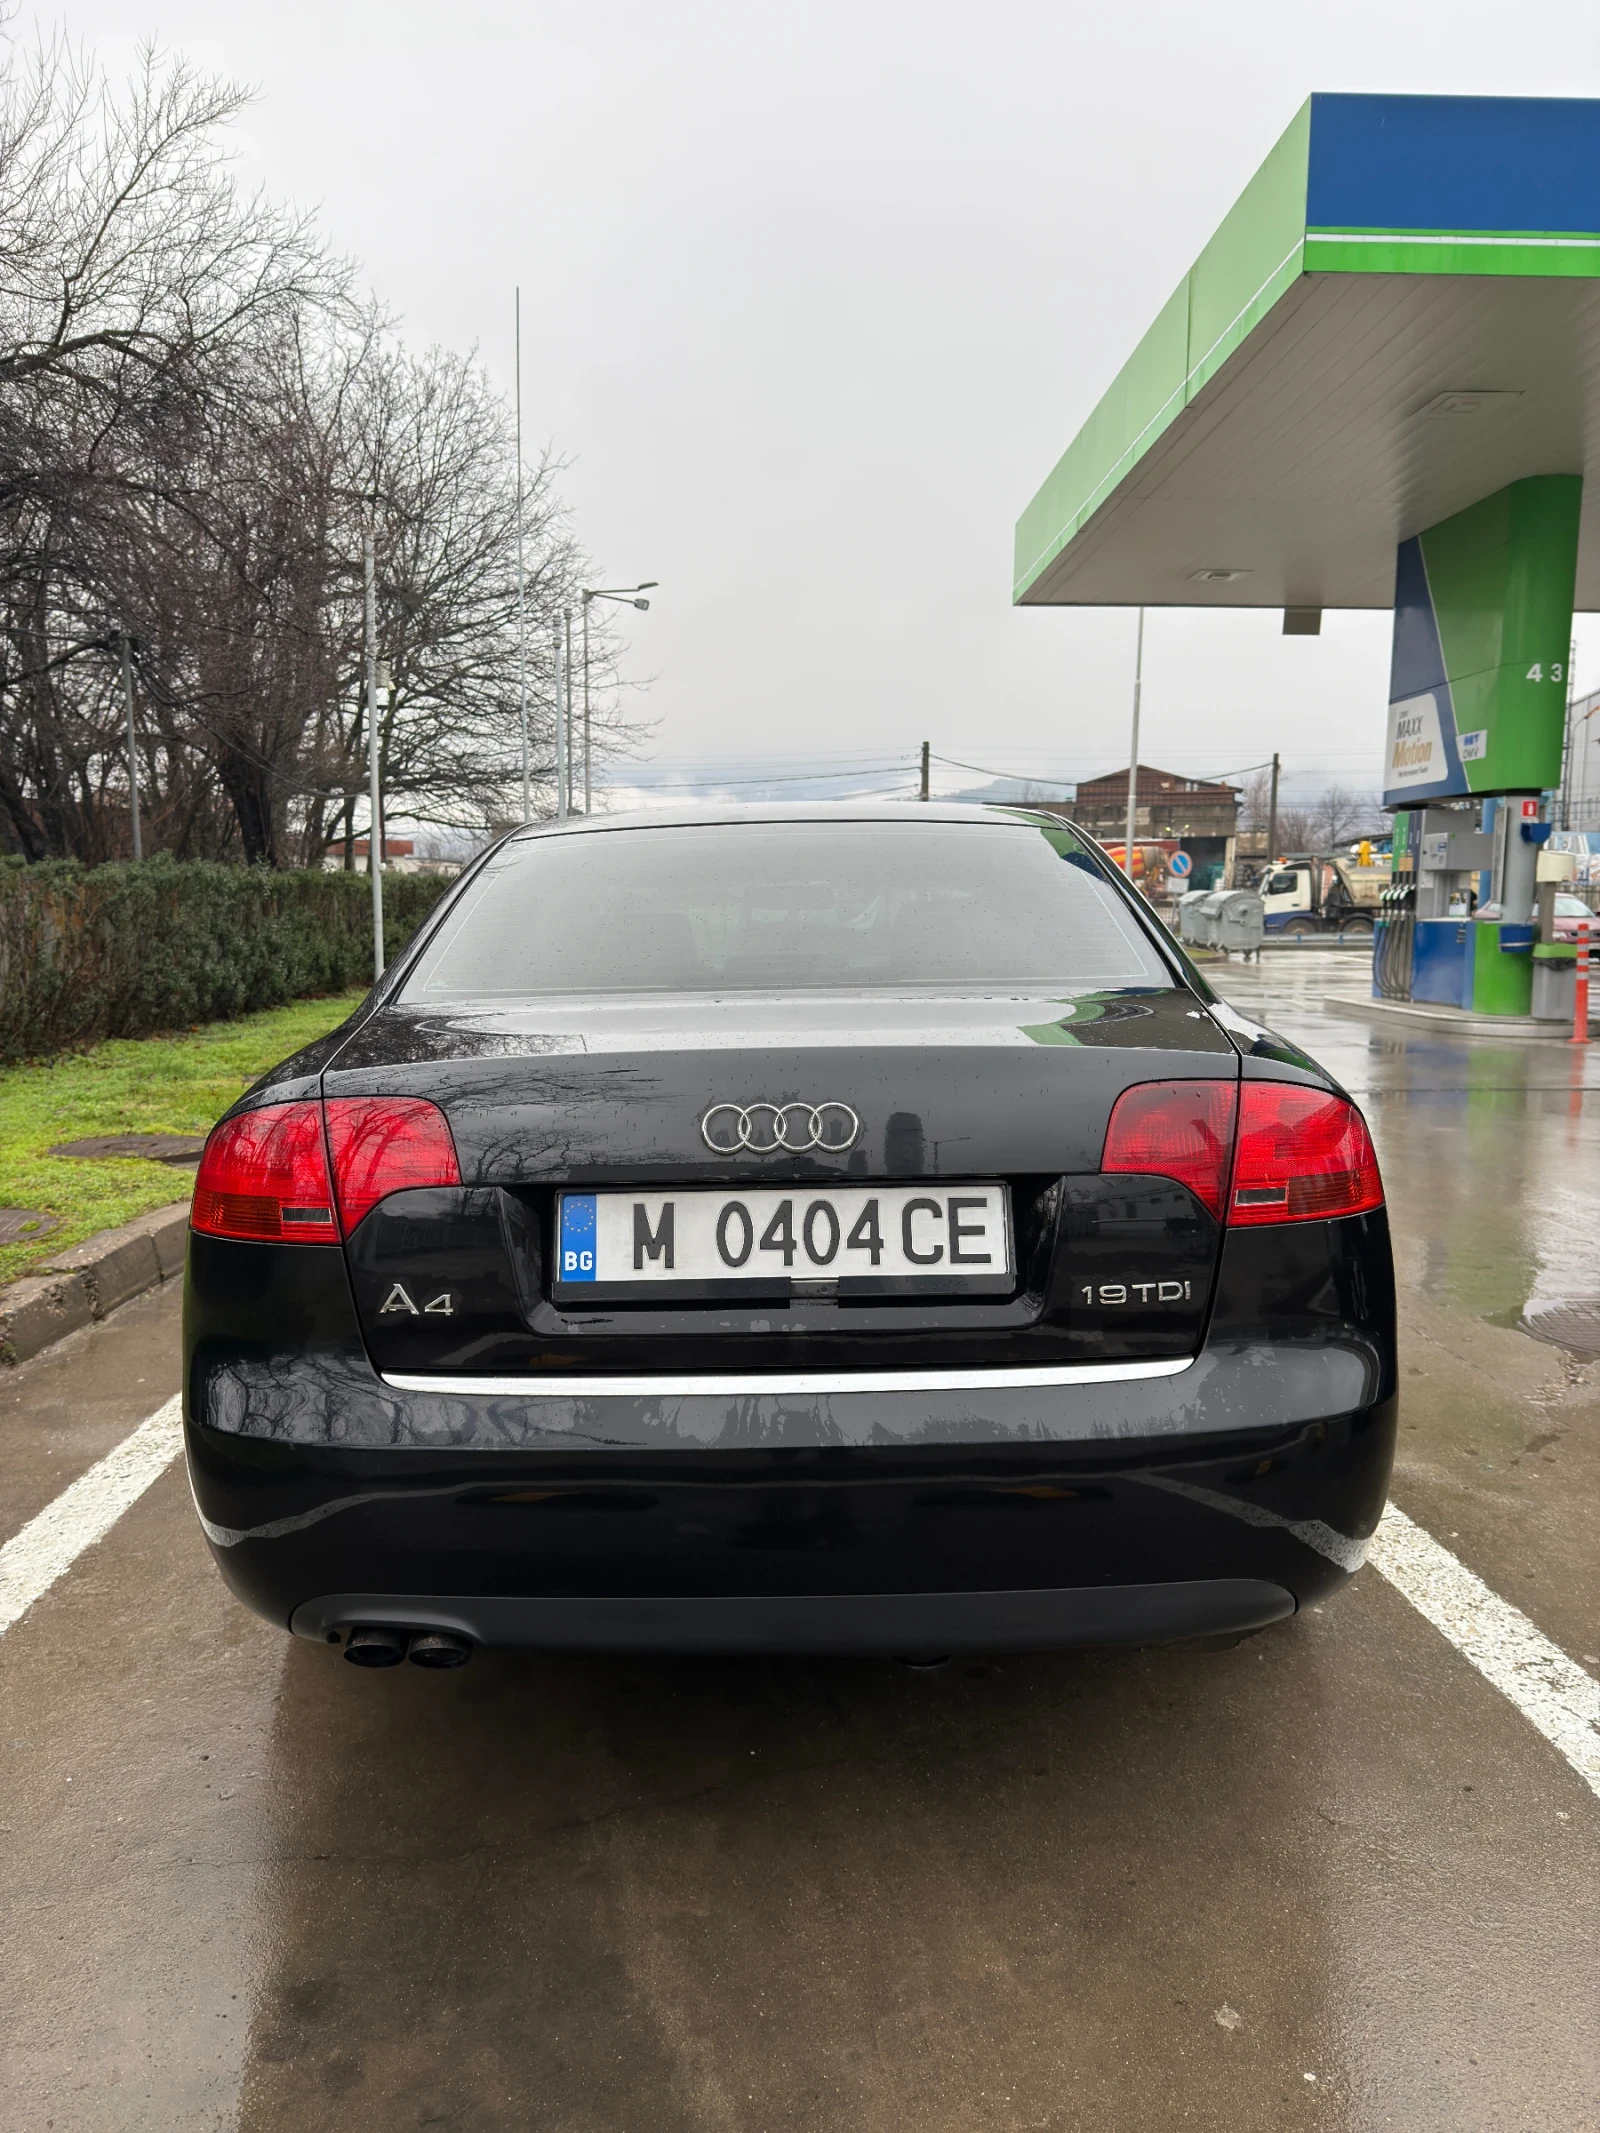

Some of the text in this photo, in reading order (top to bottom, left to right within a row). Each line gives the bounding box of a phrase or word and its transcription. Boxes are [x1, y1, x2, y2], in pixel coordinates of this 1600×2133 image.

[1525, 663, 1562, 682] 4 3
[1396, 715, 1424, 740] MAXX
[1391, 737, 1433, 769] Motion
[633, 1197, 992, 1270] M 0404 CE
[564, 1251, 593, 1271] BG
[379, 1283, 455, 1316] A4
